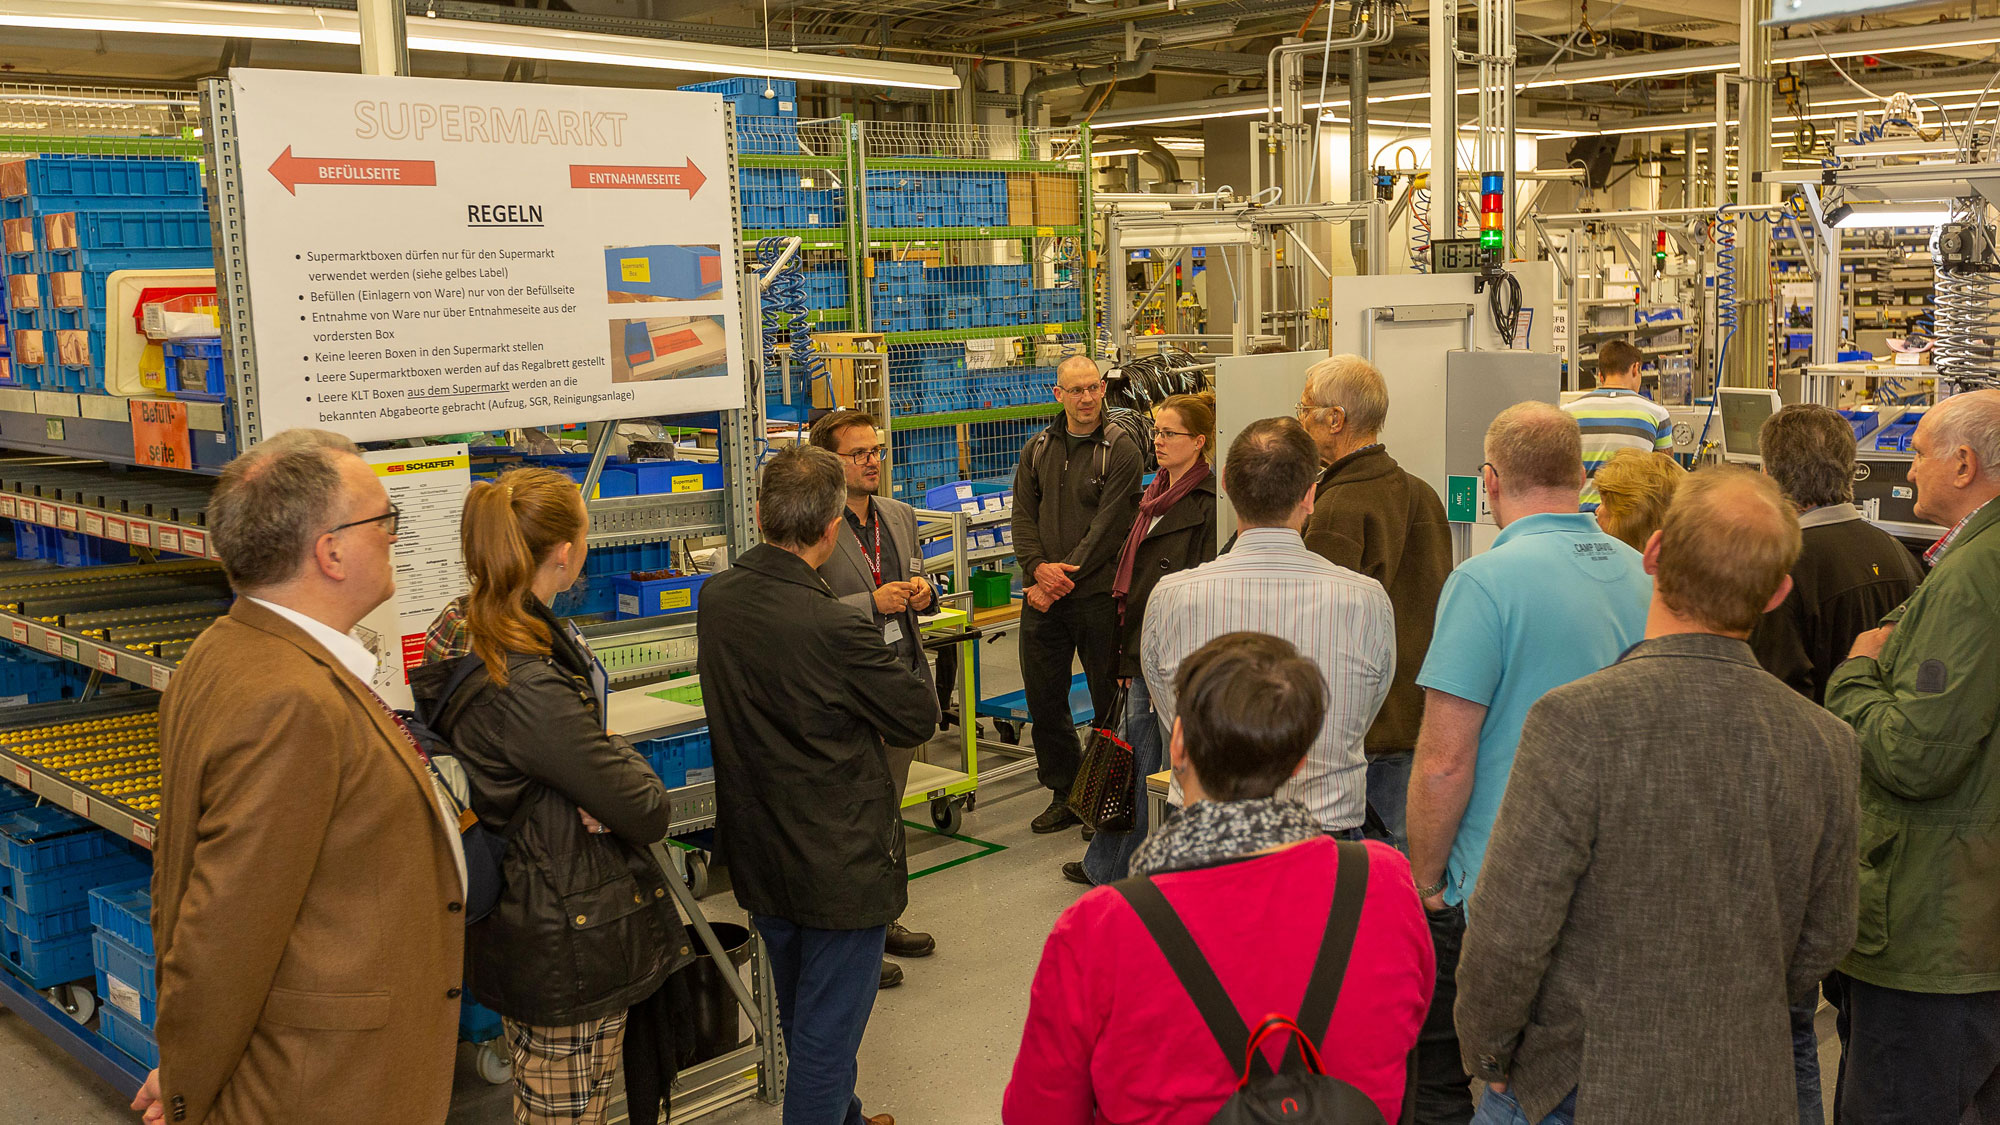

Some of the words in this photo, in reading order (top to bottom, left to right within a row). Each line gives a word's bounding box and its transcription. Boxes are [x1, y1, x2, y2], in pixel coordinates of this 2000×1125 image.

[354, 100, 628, 147] SUPERMARKT
[318, 165, 401, 181] BEFÜLLSEITE
[588, 172, 682, 187] ENTNAHMESEITE
[467, 204, 544, 224] REGELN
[306, 249, 403, 264] Supermarktboxen
[405, 249, 440, 261] dürfen
[441, 251, 460, 260] nur
[461, 248, 476, 260] für
[478, 248, 497, 260] den
[498, 248, 555, 261] Supermarkt
[308, 269, 368, 282] verwendet
[369, 269, 410, 281] werden
[412, 268, 443, 282] (siehe
[444, 267, 477, 281] gelbes
[479, 266, 509, 280] Label)
[310, 290, 356, 302] Befüllen
[358, 289, 411, 303] (Einlagern
[412, 290, 433, 299] von
[433, 287, 466, 300] Ware)
[467, 289, 485, 298] nur
[486, 288, 506, 297] von
[507, 285, 524, 297] der
[526, 284, 575, 296] Befüllseite
[311, 310, 368, 323] Entnahme
[369, 311, 390, 321] von
[391, 309, 421, 320] Ware
[423, 310, 441, 319] nur
[442, 307, 467, 318] über
[468, 304, 541, 317] Entnahmeseite
[542, 305, 560, 314] aus
[560, 303, 577, 314] der
[312, 330, 373, 342] vordersten
[375, 329, 395, 340] Box
[315, 351, 346, 363] Keine
[348, 350, 382, 361] leeren
[384, 348, 417, 359] Boxen
[419, 347, 430, 357] in
[431, 345, 451, 357] den
[453, 342, 511, 357] Supermarkt
[512, 341, 544, 353] stellen
[316, 372, 347, 383] Leere
[349, 366, 442, 383] Supermarktboxen
[444, 363, 482, 375] werden
[484, 361, 501, 373] auf
[502, 361, 520, 372] das
[521, 359, 570, 372] Regalbrett
[571, 356, 606, 370] gestellt
[317, 392, 348, 404] Leere
[350, 389, 370, 401] KLT
[372, 389, 405, 400] Boxen
[407, 387, 426, 397] aus
[427, 384, 450, 396] dem
[452, 381, 510, 395] Supermarkt
[511, 378, 549, 390] werden
[549, 379, 562, 389] an
[563, 376, 579, 388] die
[142, 402, 175, 424] Befüll-
[319, 410, 377, 423] bekannten
[379, 405, 440, 420] Abgabeorte
[441, 400, 486, 416] gebracht
[488, 398, 528, 412] (Aufzug,
[529, 396, 551, 407] SGR,
[553, 389, 635, 406] Reinigungsanlage)
[149, 441, 175, 463] seite
